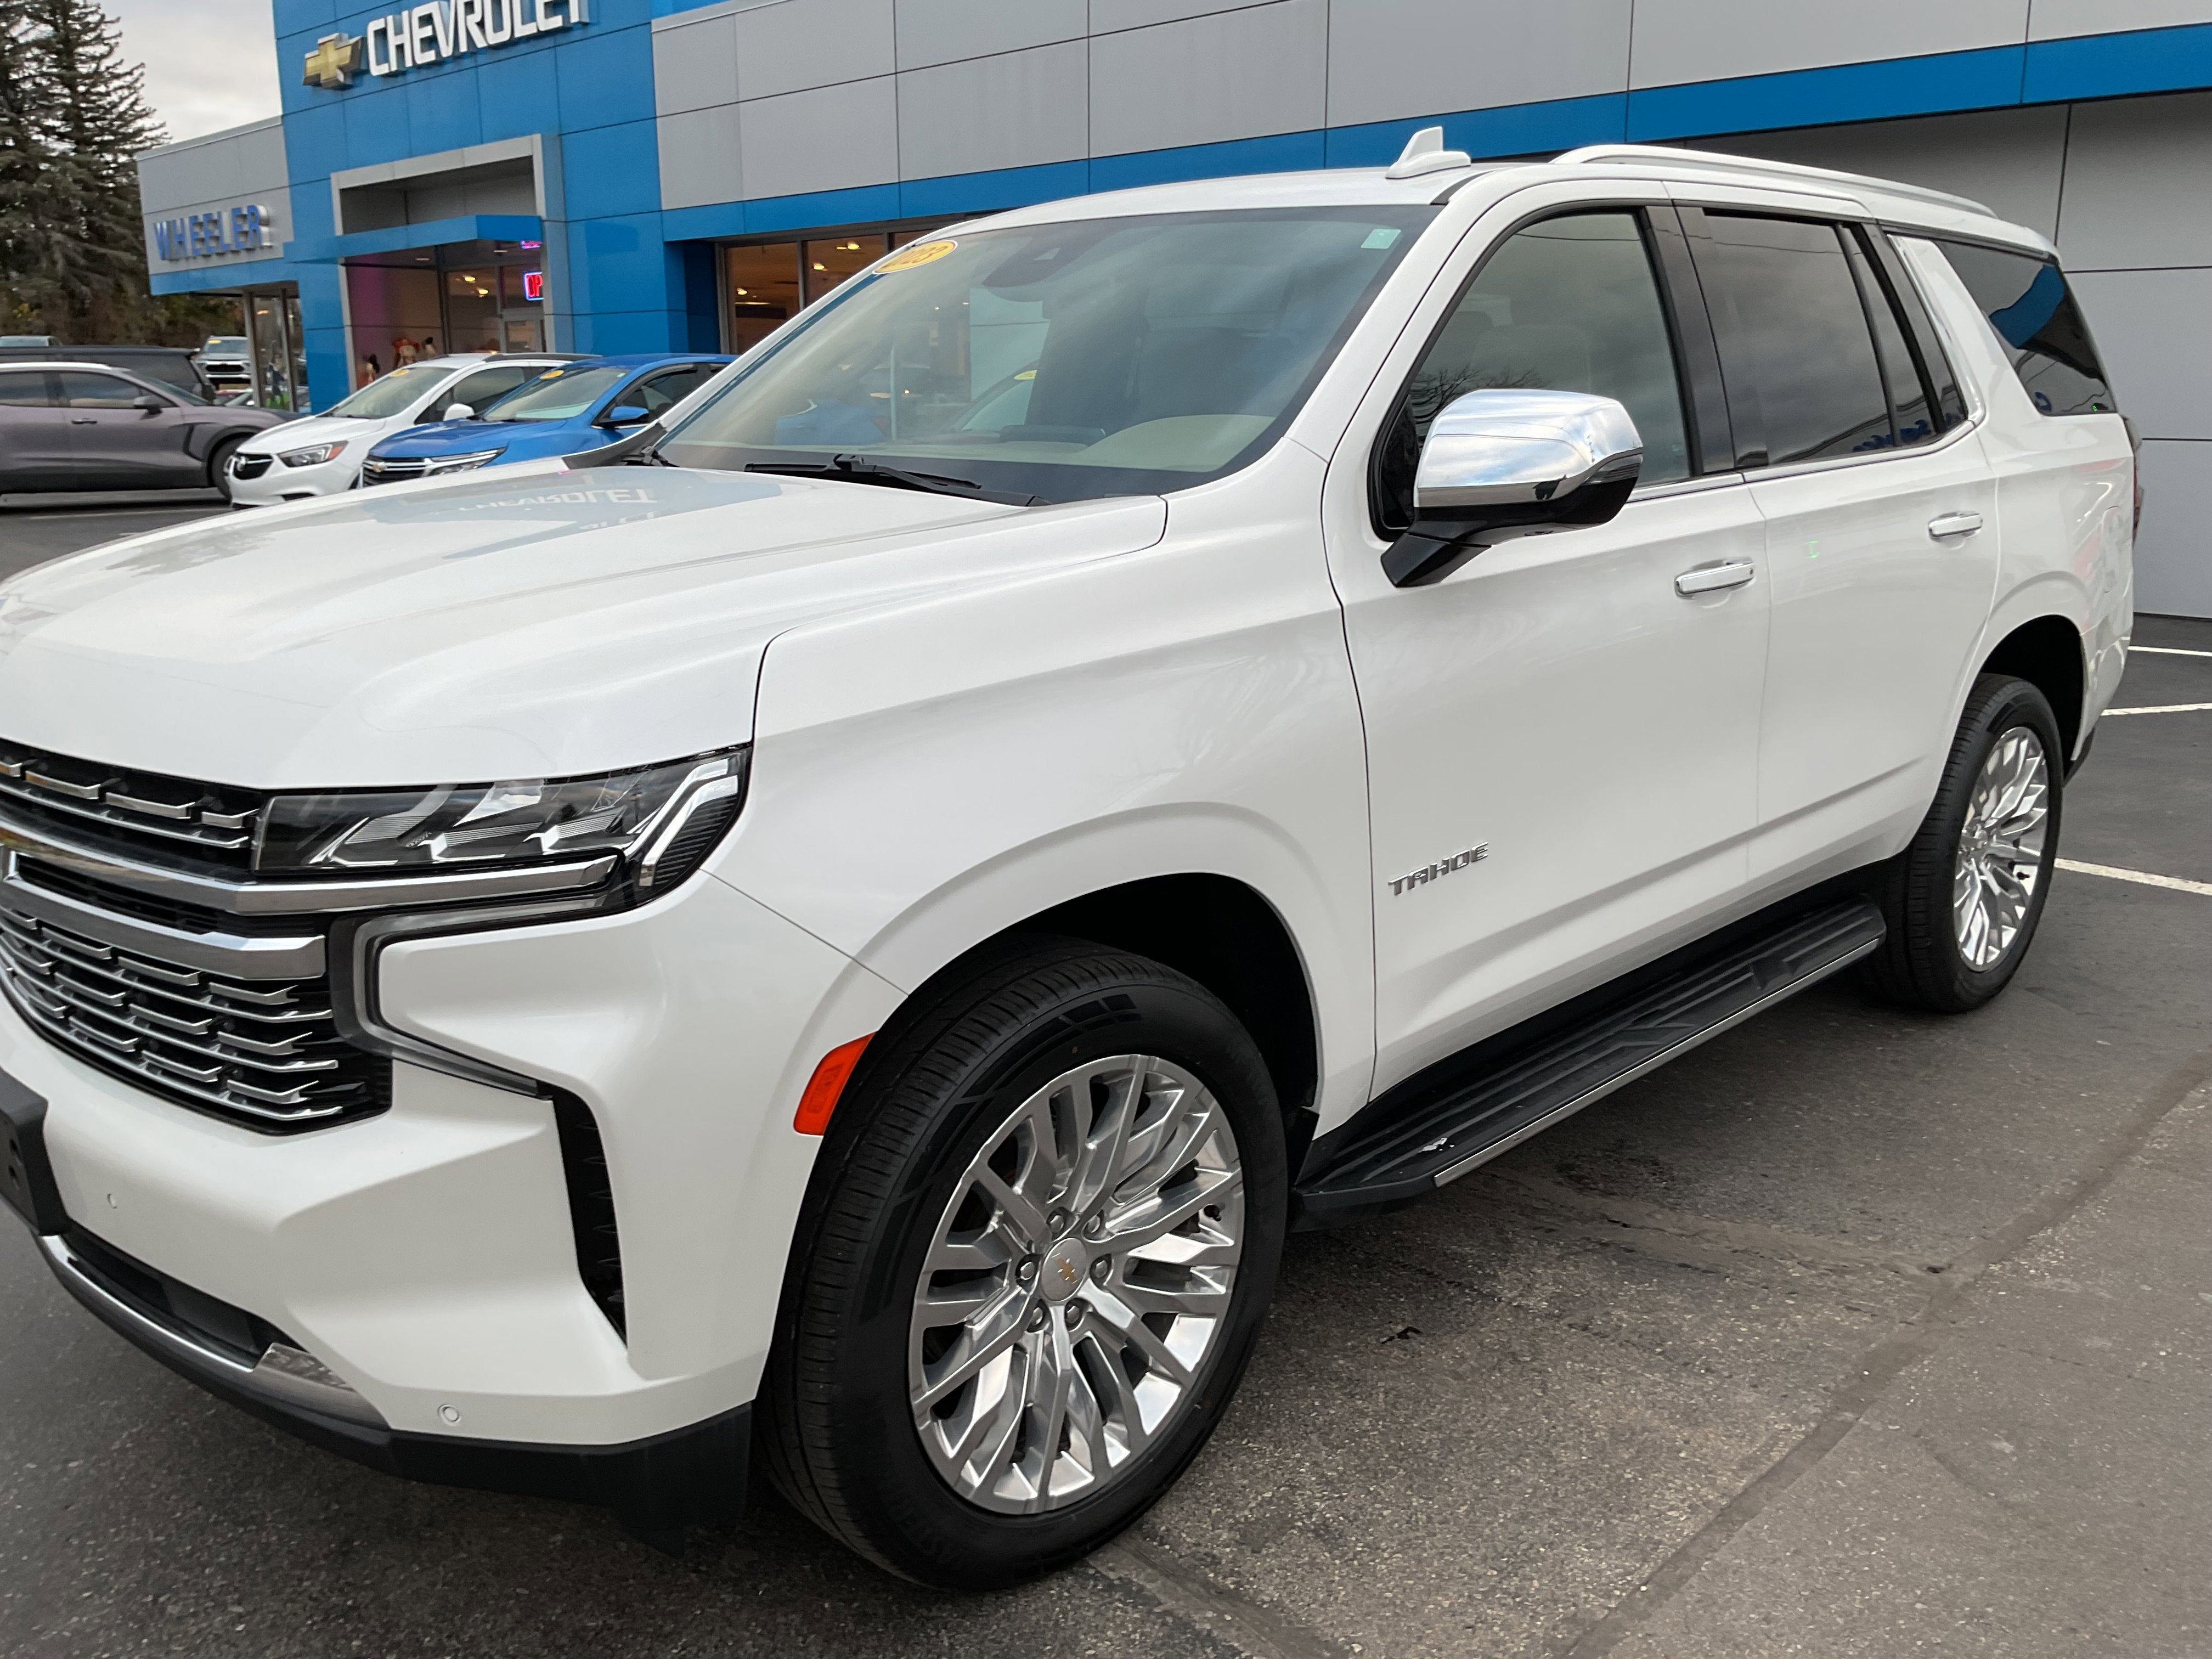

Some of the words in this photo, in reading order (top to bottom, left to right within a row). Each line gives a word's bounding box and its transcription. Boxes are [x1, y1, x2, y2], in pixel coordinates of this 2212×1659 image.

[154, 205, 268, 261] WHEELER
[527, 274, 543, 297] OP
[1387, 841, 1488, 896] TAHOE
